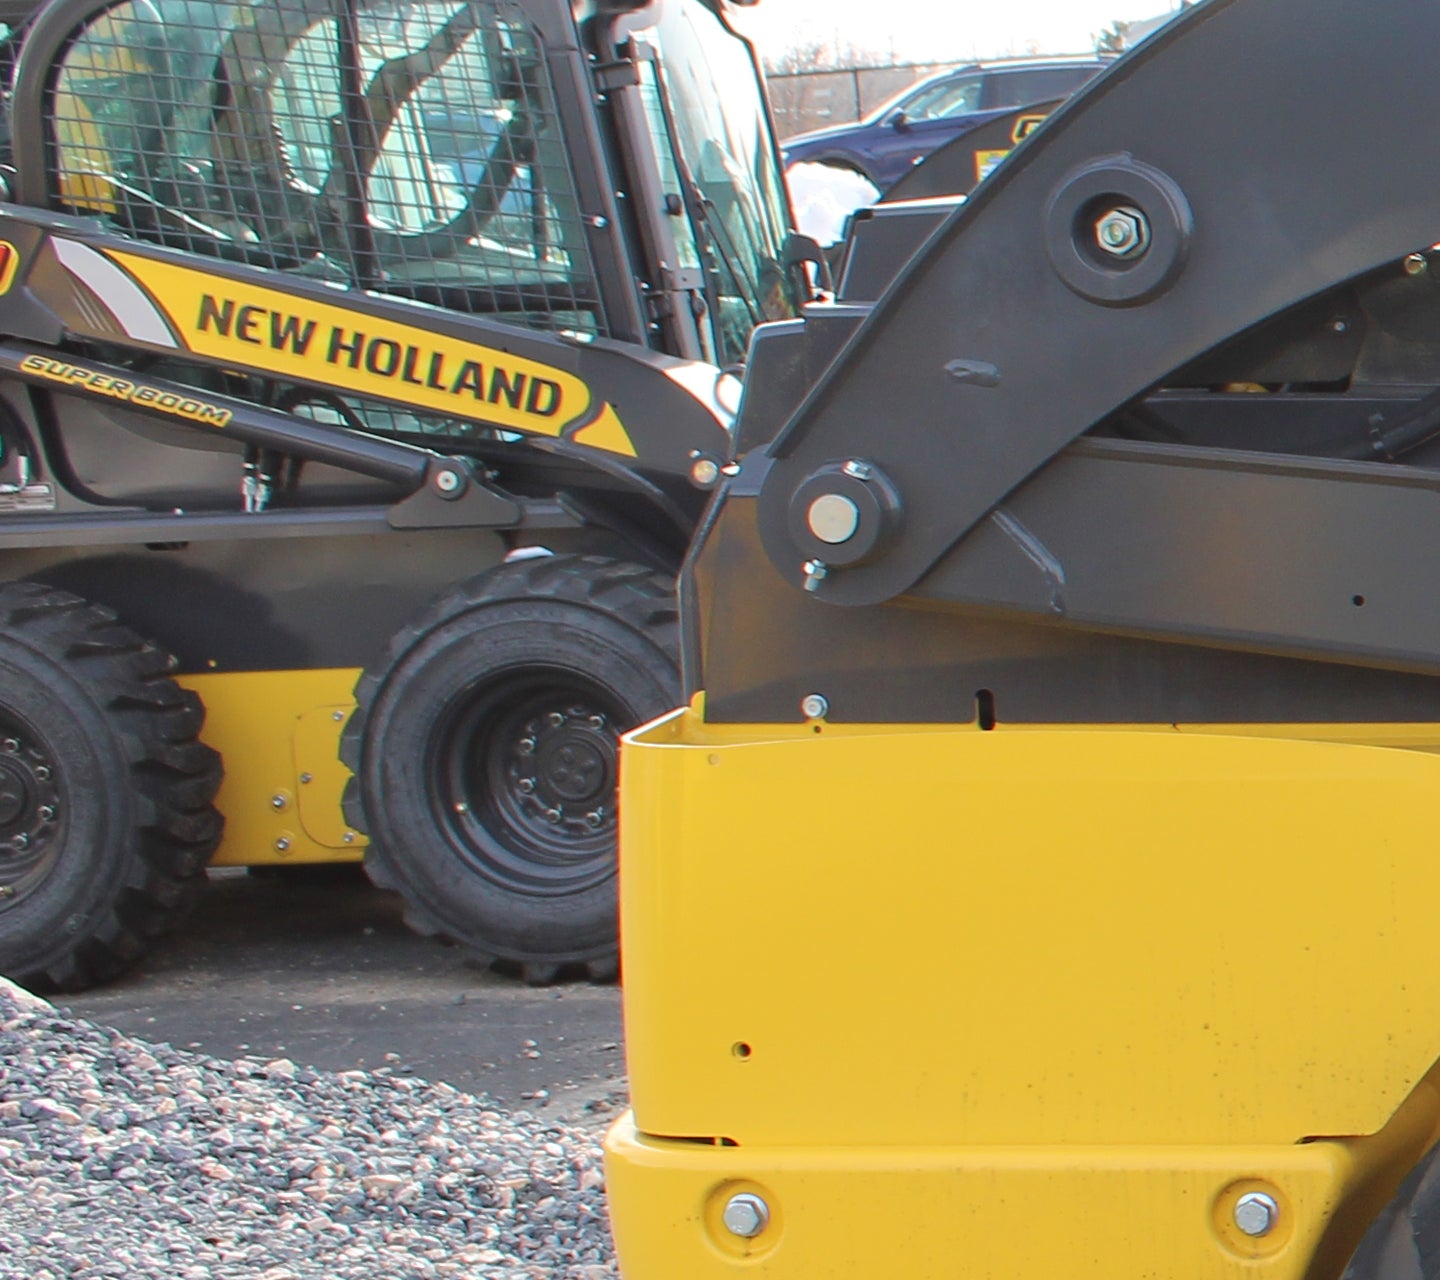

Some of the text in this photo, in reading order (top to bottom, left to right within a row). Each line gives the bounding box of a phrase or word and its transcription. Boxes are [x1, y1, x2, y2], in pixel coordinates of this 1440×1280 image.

[20, 354, 233, 428] SUPER BOOM
[196, 294, 564, 417] NEW HOLLAND
